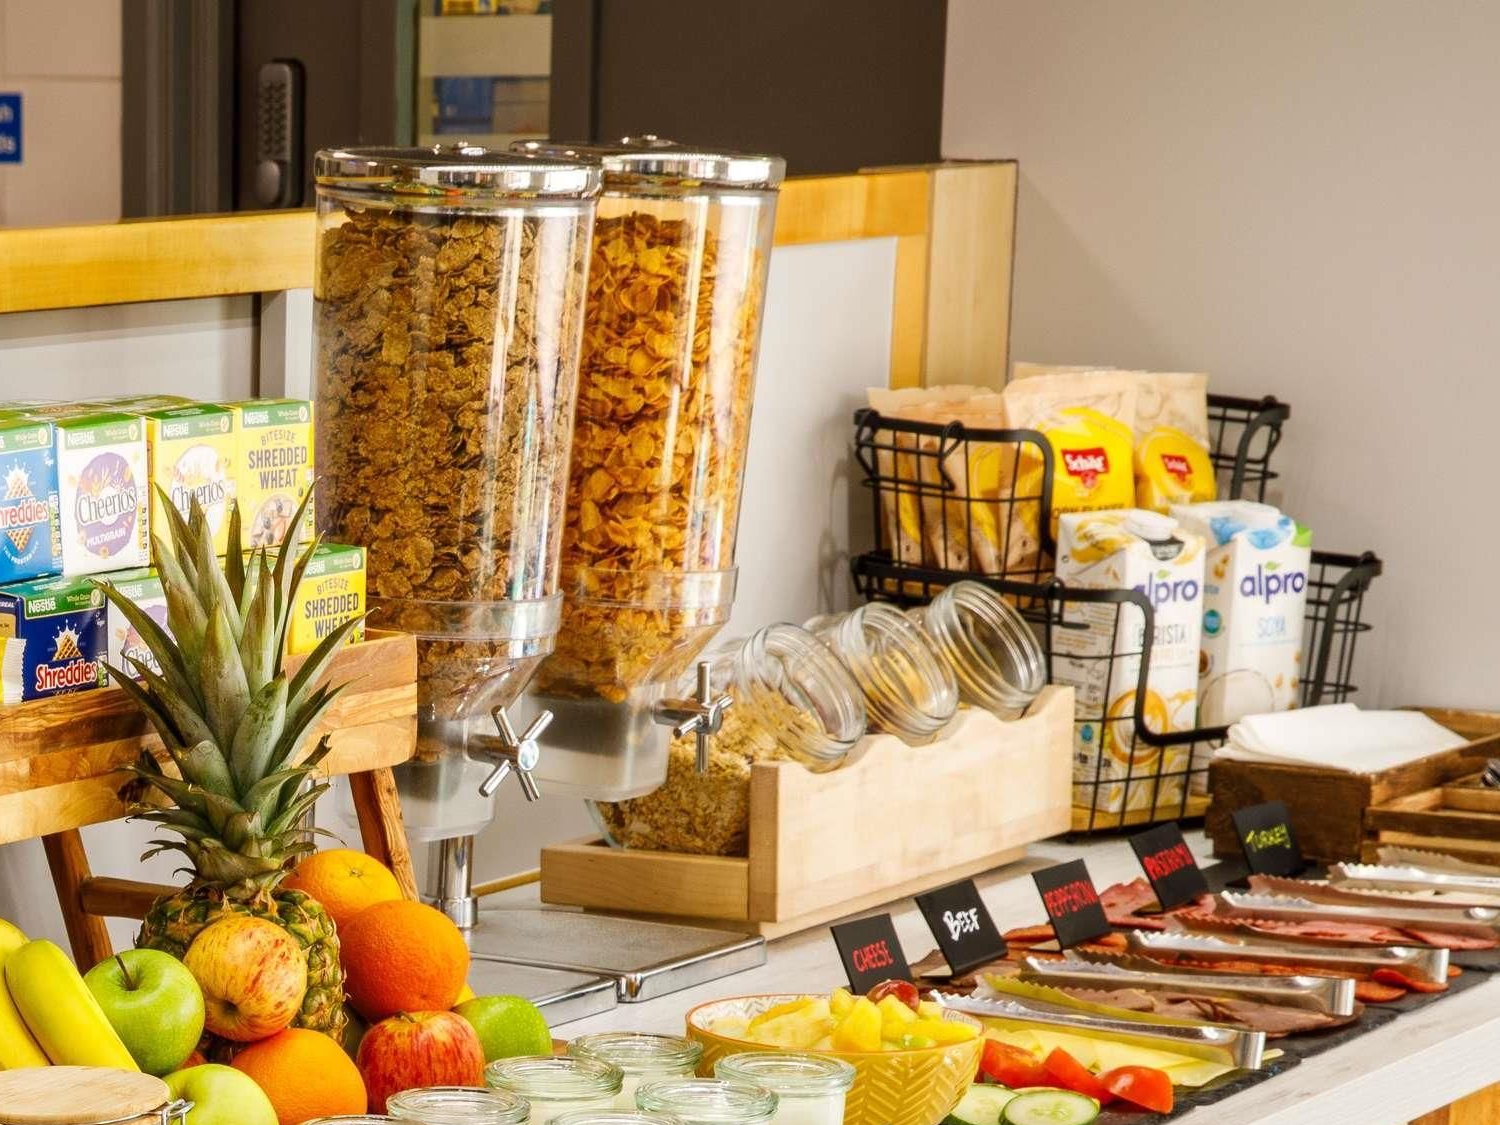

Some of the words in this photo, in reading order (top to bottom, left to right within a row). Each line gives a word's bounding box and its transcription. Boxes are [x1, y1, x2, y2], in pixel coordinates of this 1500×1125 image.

[261, 428, 296, 446] BITESIZE
[248, 446, 308, 469] SHREDDED
[259, 469, 298, 489] WHEAT
[79, 488, 136, 525] Cheerios
[316, 578, 349, 595] BITESIZE
[1240, 563, 1305, 604] alpro
[304, 592, 359, 619] SHREDDED
[35, 660, 98, 691] Shreddies
[852, 940, 894, 973] CHEESE
